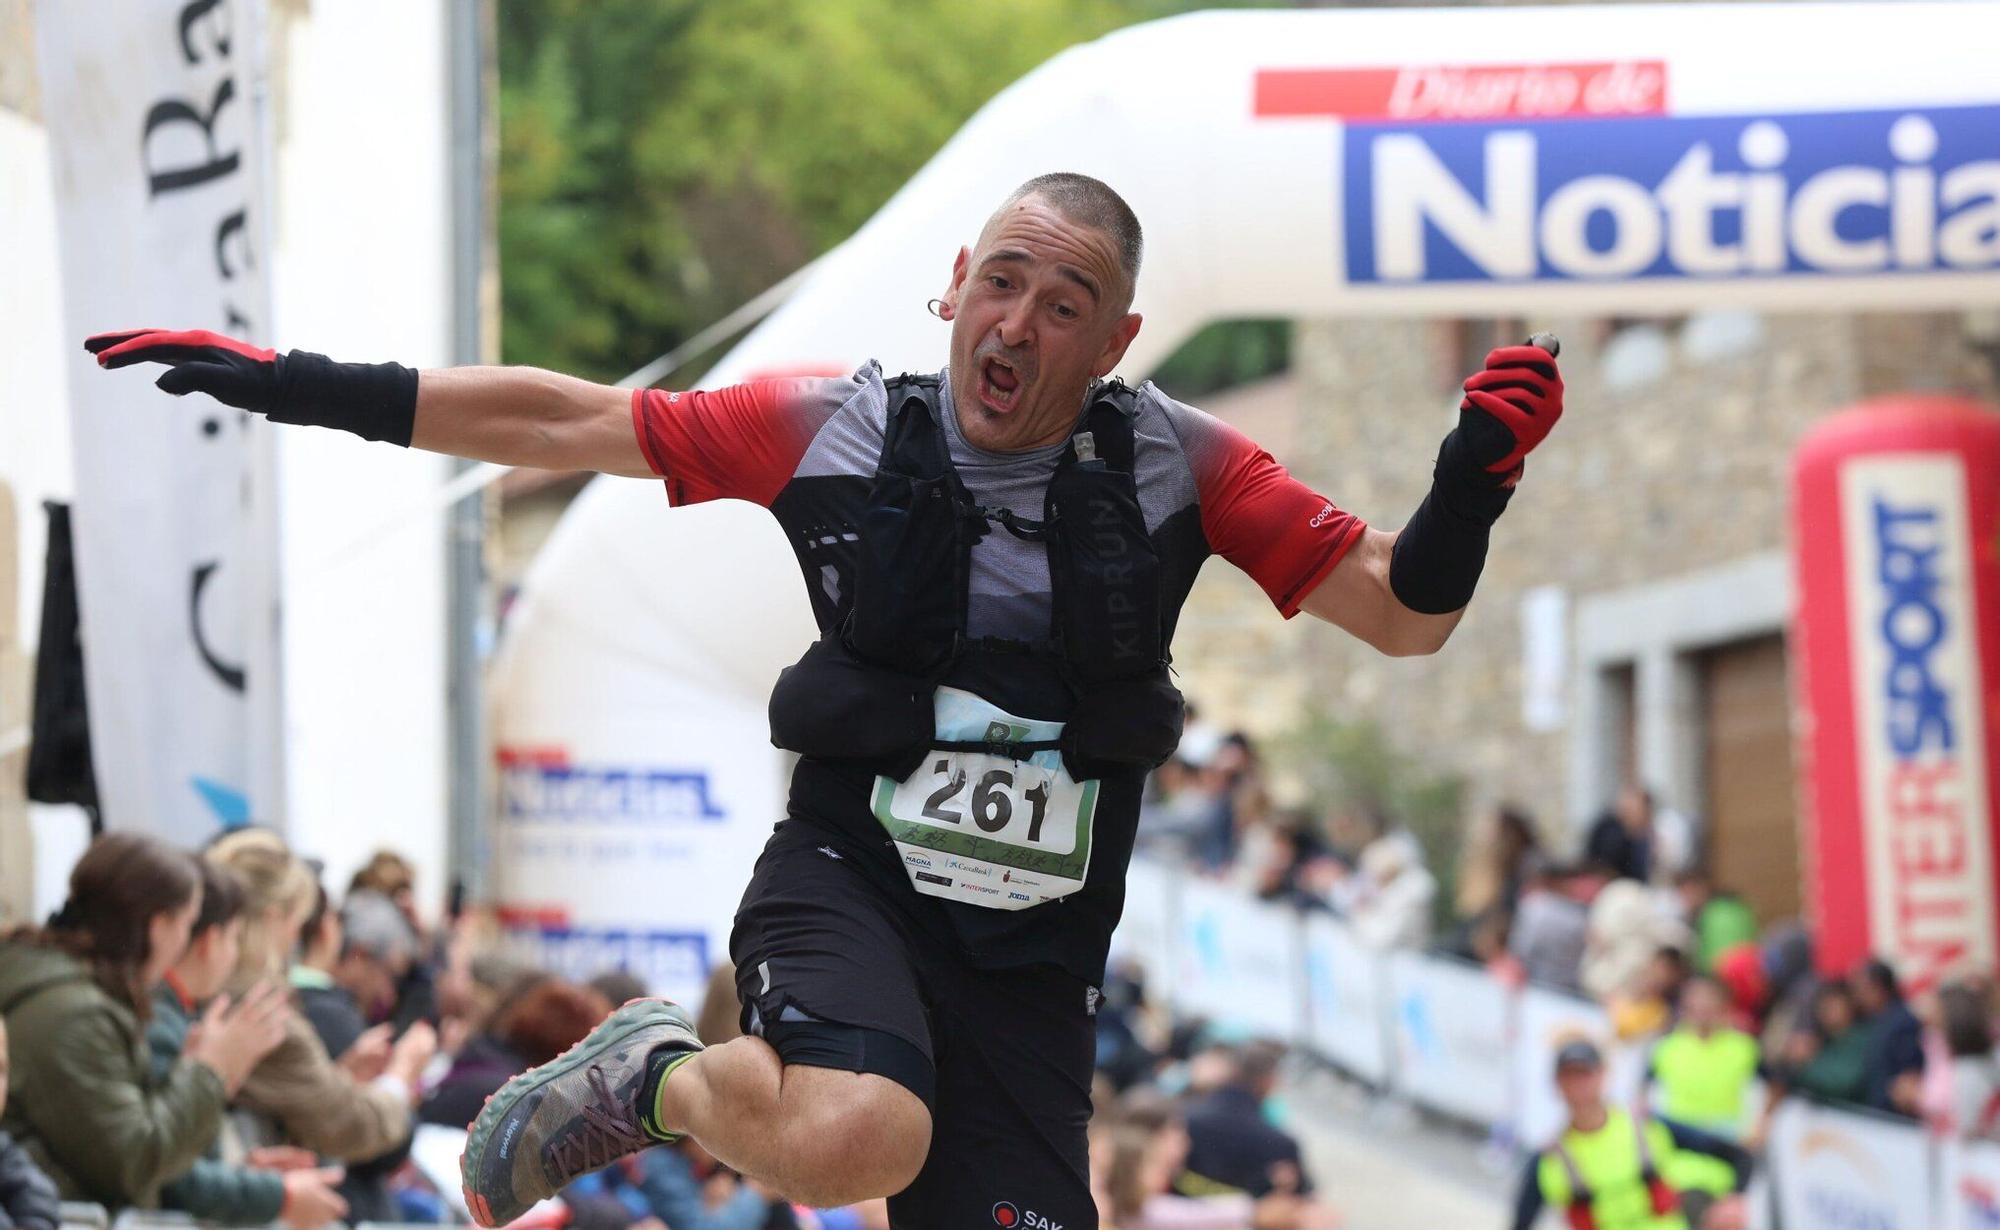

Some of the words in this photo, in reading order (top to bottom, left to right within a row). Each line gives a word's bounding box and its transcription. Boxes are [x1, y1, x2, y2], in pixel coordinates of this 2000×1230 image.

[1387, 63, 1580, 120] Diario
[1583, 58, 1664, 115] de
[1371, 114, 2000, 281] Noticia
[1088, 500, 1144, 660] KIPRUN
[1872, 488, 1967, 998] NTERSPORT
[921, 759, 1049, 843] 261
[905, 855, 932, 867] MAGNA
[965, 884, 1000, 896] INTERSPORT
